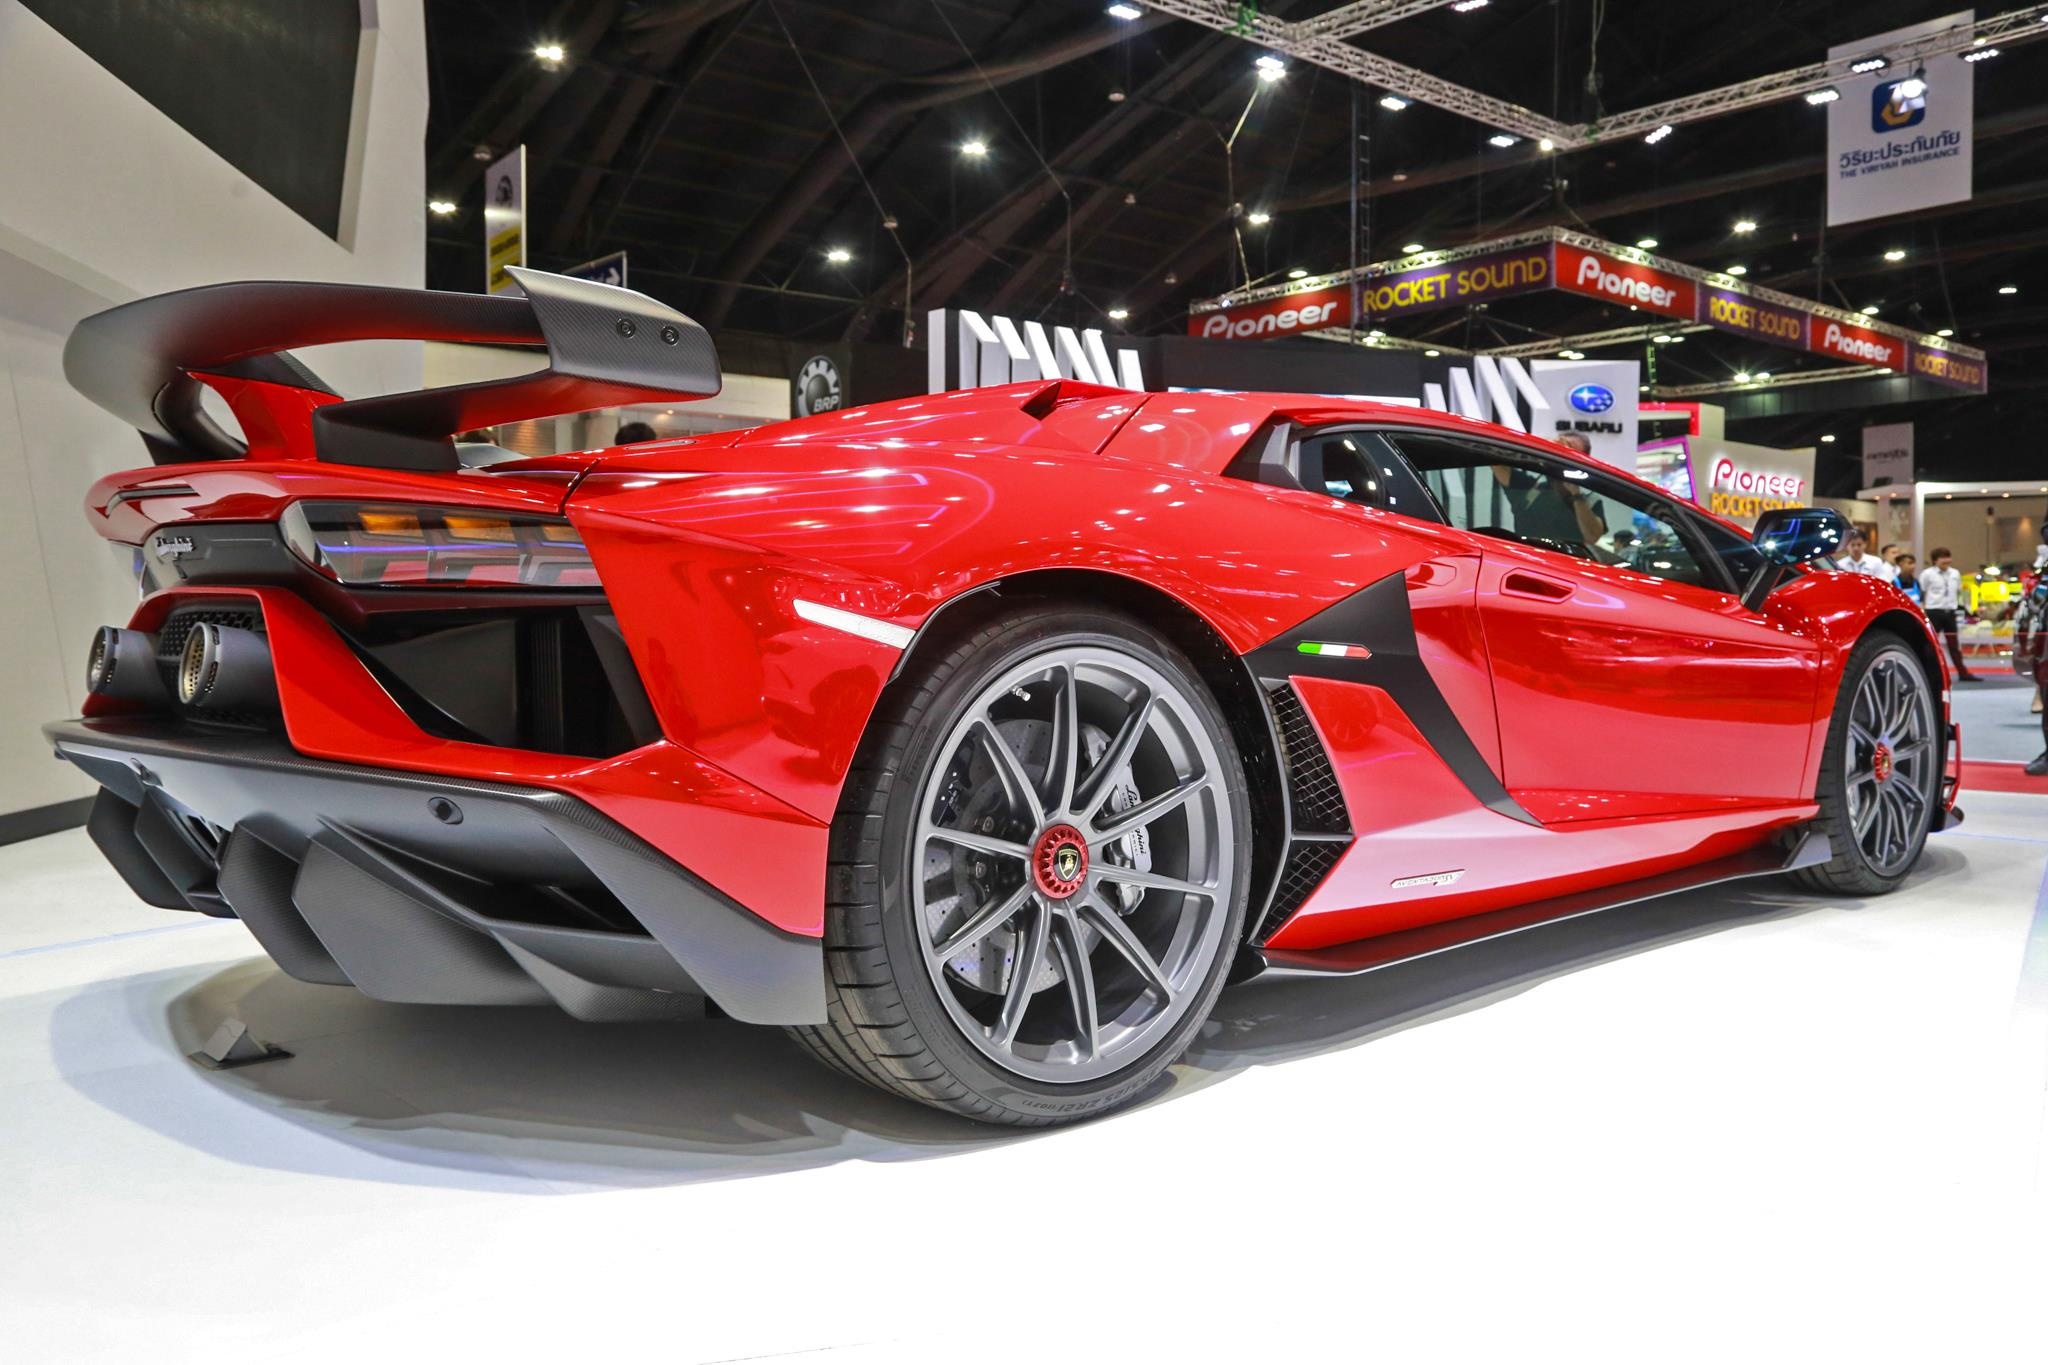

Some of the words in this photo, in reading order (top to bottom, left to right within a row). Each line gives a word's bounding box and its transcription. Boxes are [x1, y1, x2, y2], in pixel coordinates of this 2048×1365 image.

[1840, 168, 1857, 179] THE
[1901, 147, 1960, 167] INSURANCE
[1363, 273, 1453, 314] ROCKET
[1457, 256, 1548, 296] SOUND
[1577, 256, 1677, 308] Pioneer
[1203, 301, 1337, 338] Pioneer
[1709, 296, 1757, 329] ROCKET
[1759, 310, 1801, 340] SOUND
[1824, 323, 1892, 362] Pioneer
[1914, 352, 1949, 378] ROCKET
[814, 395, 840, 413] BRP
[1556, 420, 1623, 434] SUBARU
[1713, 457, 1806, 497] Pioneer
[1711, 492, 1761, 518] ROCKET
